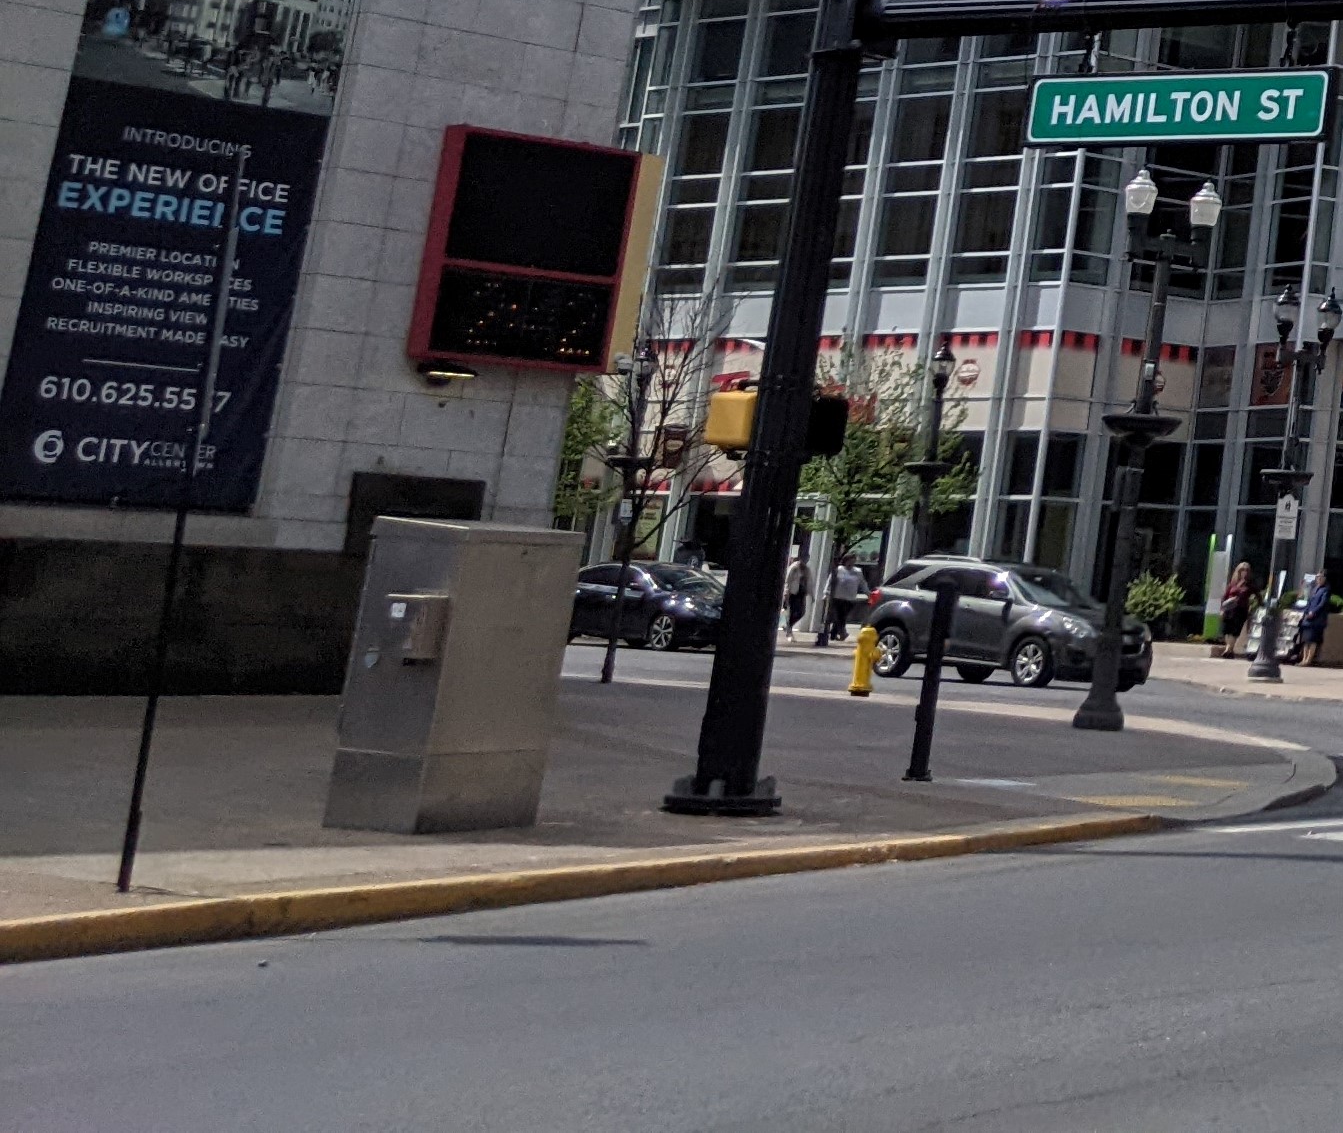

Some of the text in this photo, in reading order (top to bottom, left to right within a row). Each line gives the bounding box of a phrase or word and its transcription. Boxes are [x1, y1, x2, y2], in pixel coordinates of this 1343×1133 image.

[1050, 88, 1305, 125] HAMILTON ST
[123, 125, 253, 159] INTRODUCING
[69, 153, 121, 179] THE
[127, 163, 193, 189] NEW
[88, 241, 241, 270] PREMIER LOCATIN
[67, 258, 253, 292] FLEXIBLE WORKSPCES
[51, 277, 259, 311] ONE-OF-A-KIND AMETIES
[86, 300, 165, 321] INSPIRING
[47, 316, 250, 348] RECRUITMENT MADE ASY
[39, 376, 232, 413] 610.625.557
[76, 435, 217, 464] CITYCENER
